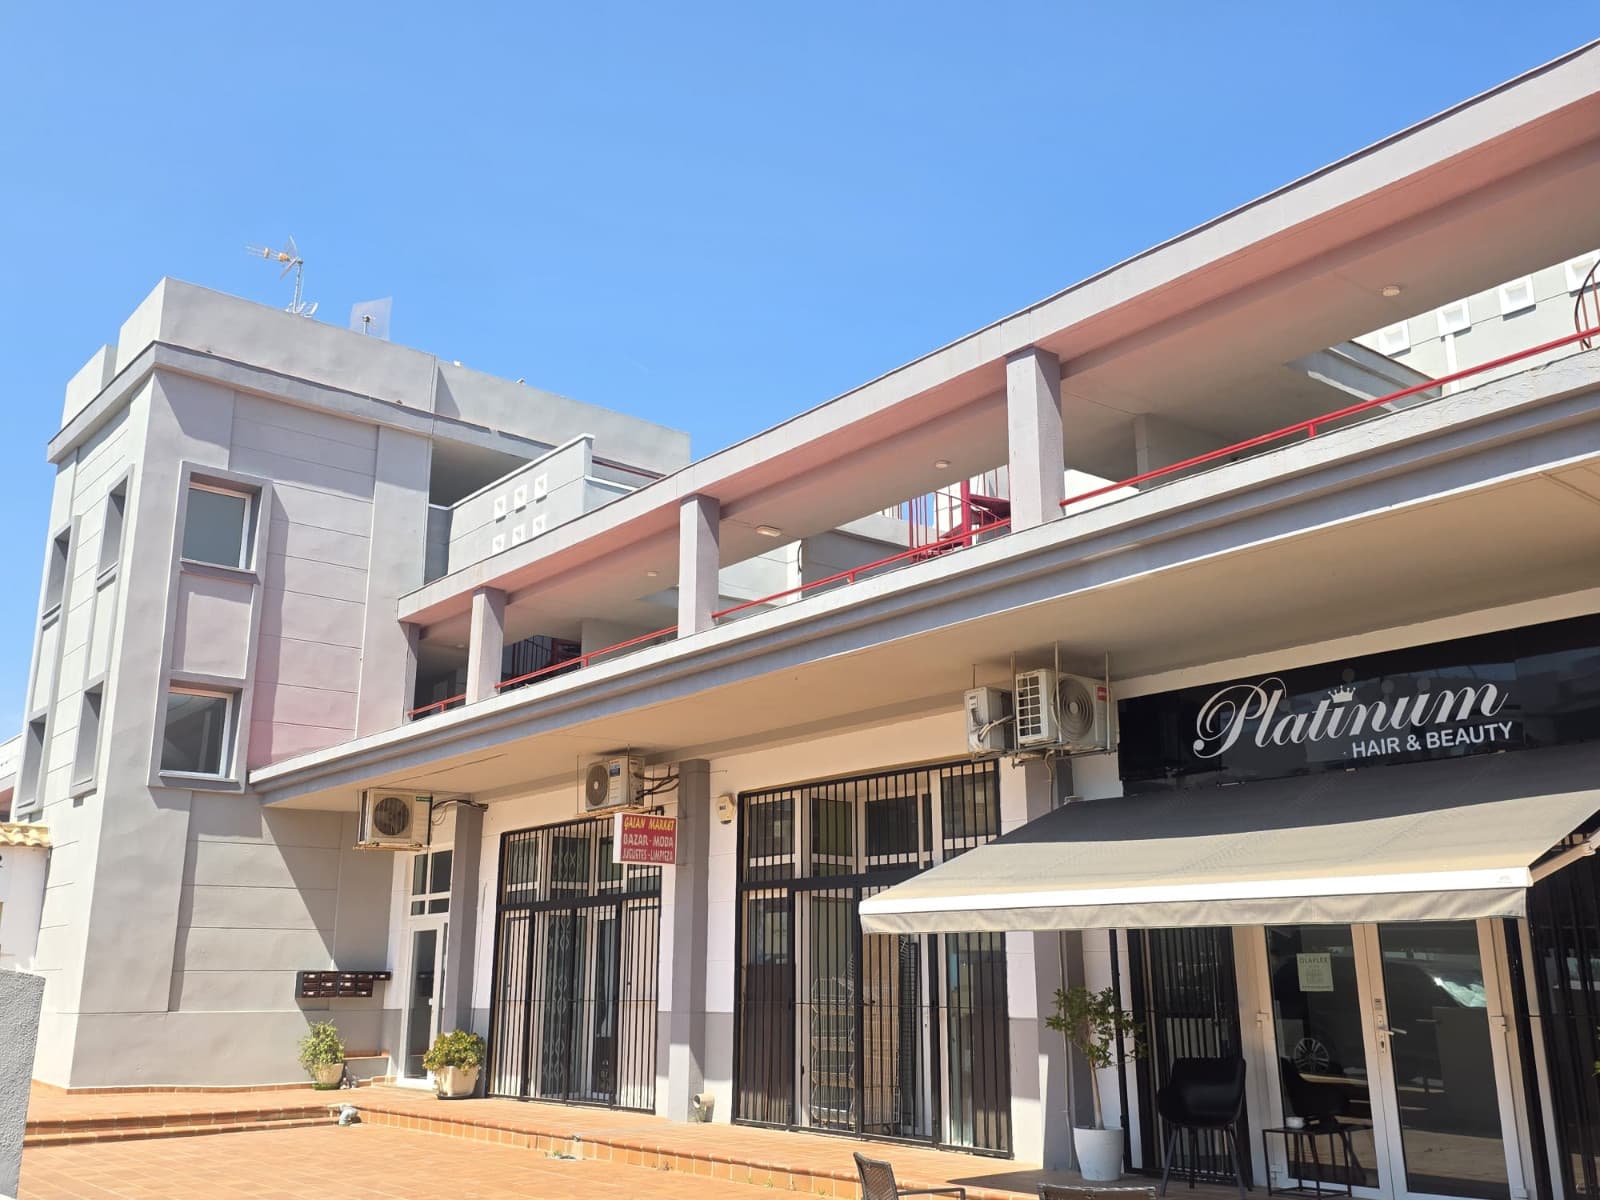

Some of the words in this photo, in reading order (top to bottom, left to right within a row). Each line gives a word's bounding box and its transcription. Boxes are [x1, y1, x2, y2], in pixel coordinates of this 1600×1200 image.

[1193, 677, 1508, 758] Platinum
[1352, 737, 1401, 759] HAIR
[1406, 733, 1422, 751] &
[1426, 720, 1513, 749] BEAUTY
[648, 818, 675, 832] MARKET
[623, 833, 648, 846] BAZAR
[652, 835, 673, 848] MODA
[623, 847, 646, 860] JUGUETES
